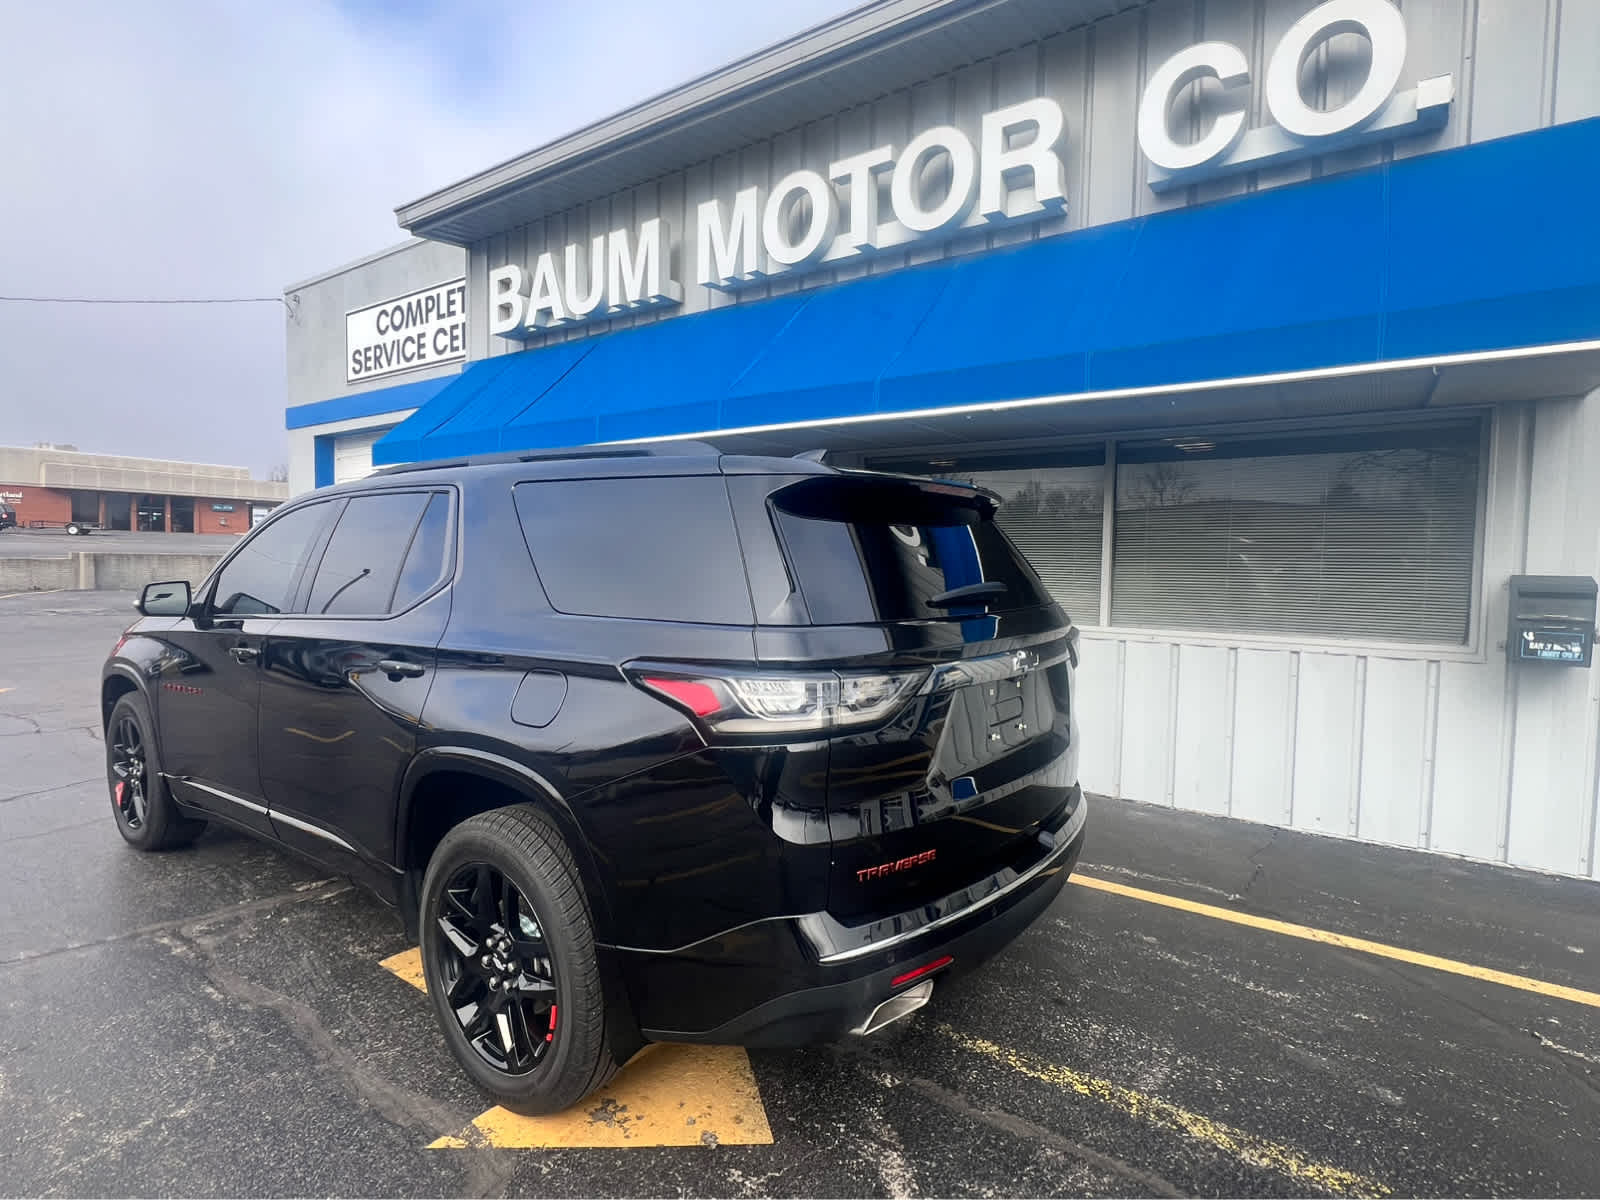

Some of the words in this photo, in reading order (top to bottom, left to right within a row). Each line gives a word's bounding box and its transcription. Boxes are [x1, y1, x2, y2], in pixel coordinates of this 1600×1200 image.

[489, 217, 661, 336] BAUM
[697, 97, 1064, 285] MOTOR
[1138, 0, 1454, 169] CO.
[352, 332, 426, 374] SERVICE
[856, 849, 937, 882] TRAVERSE
